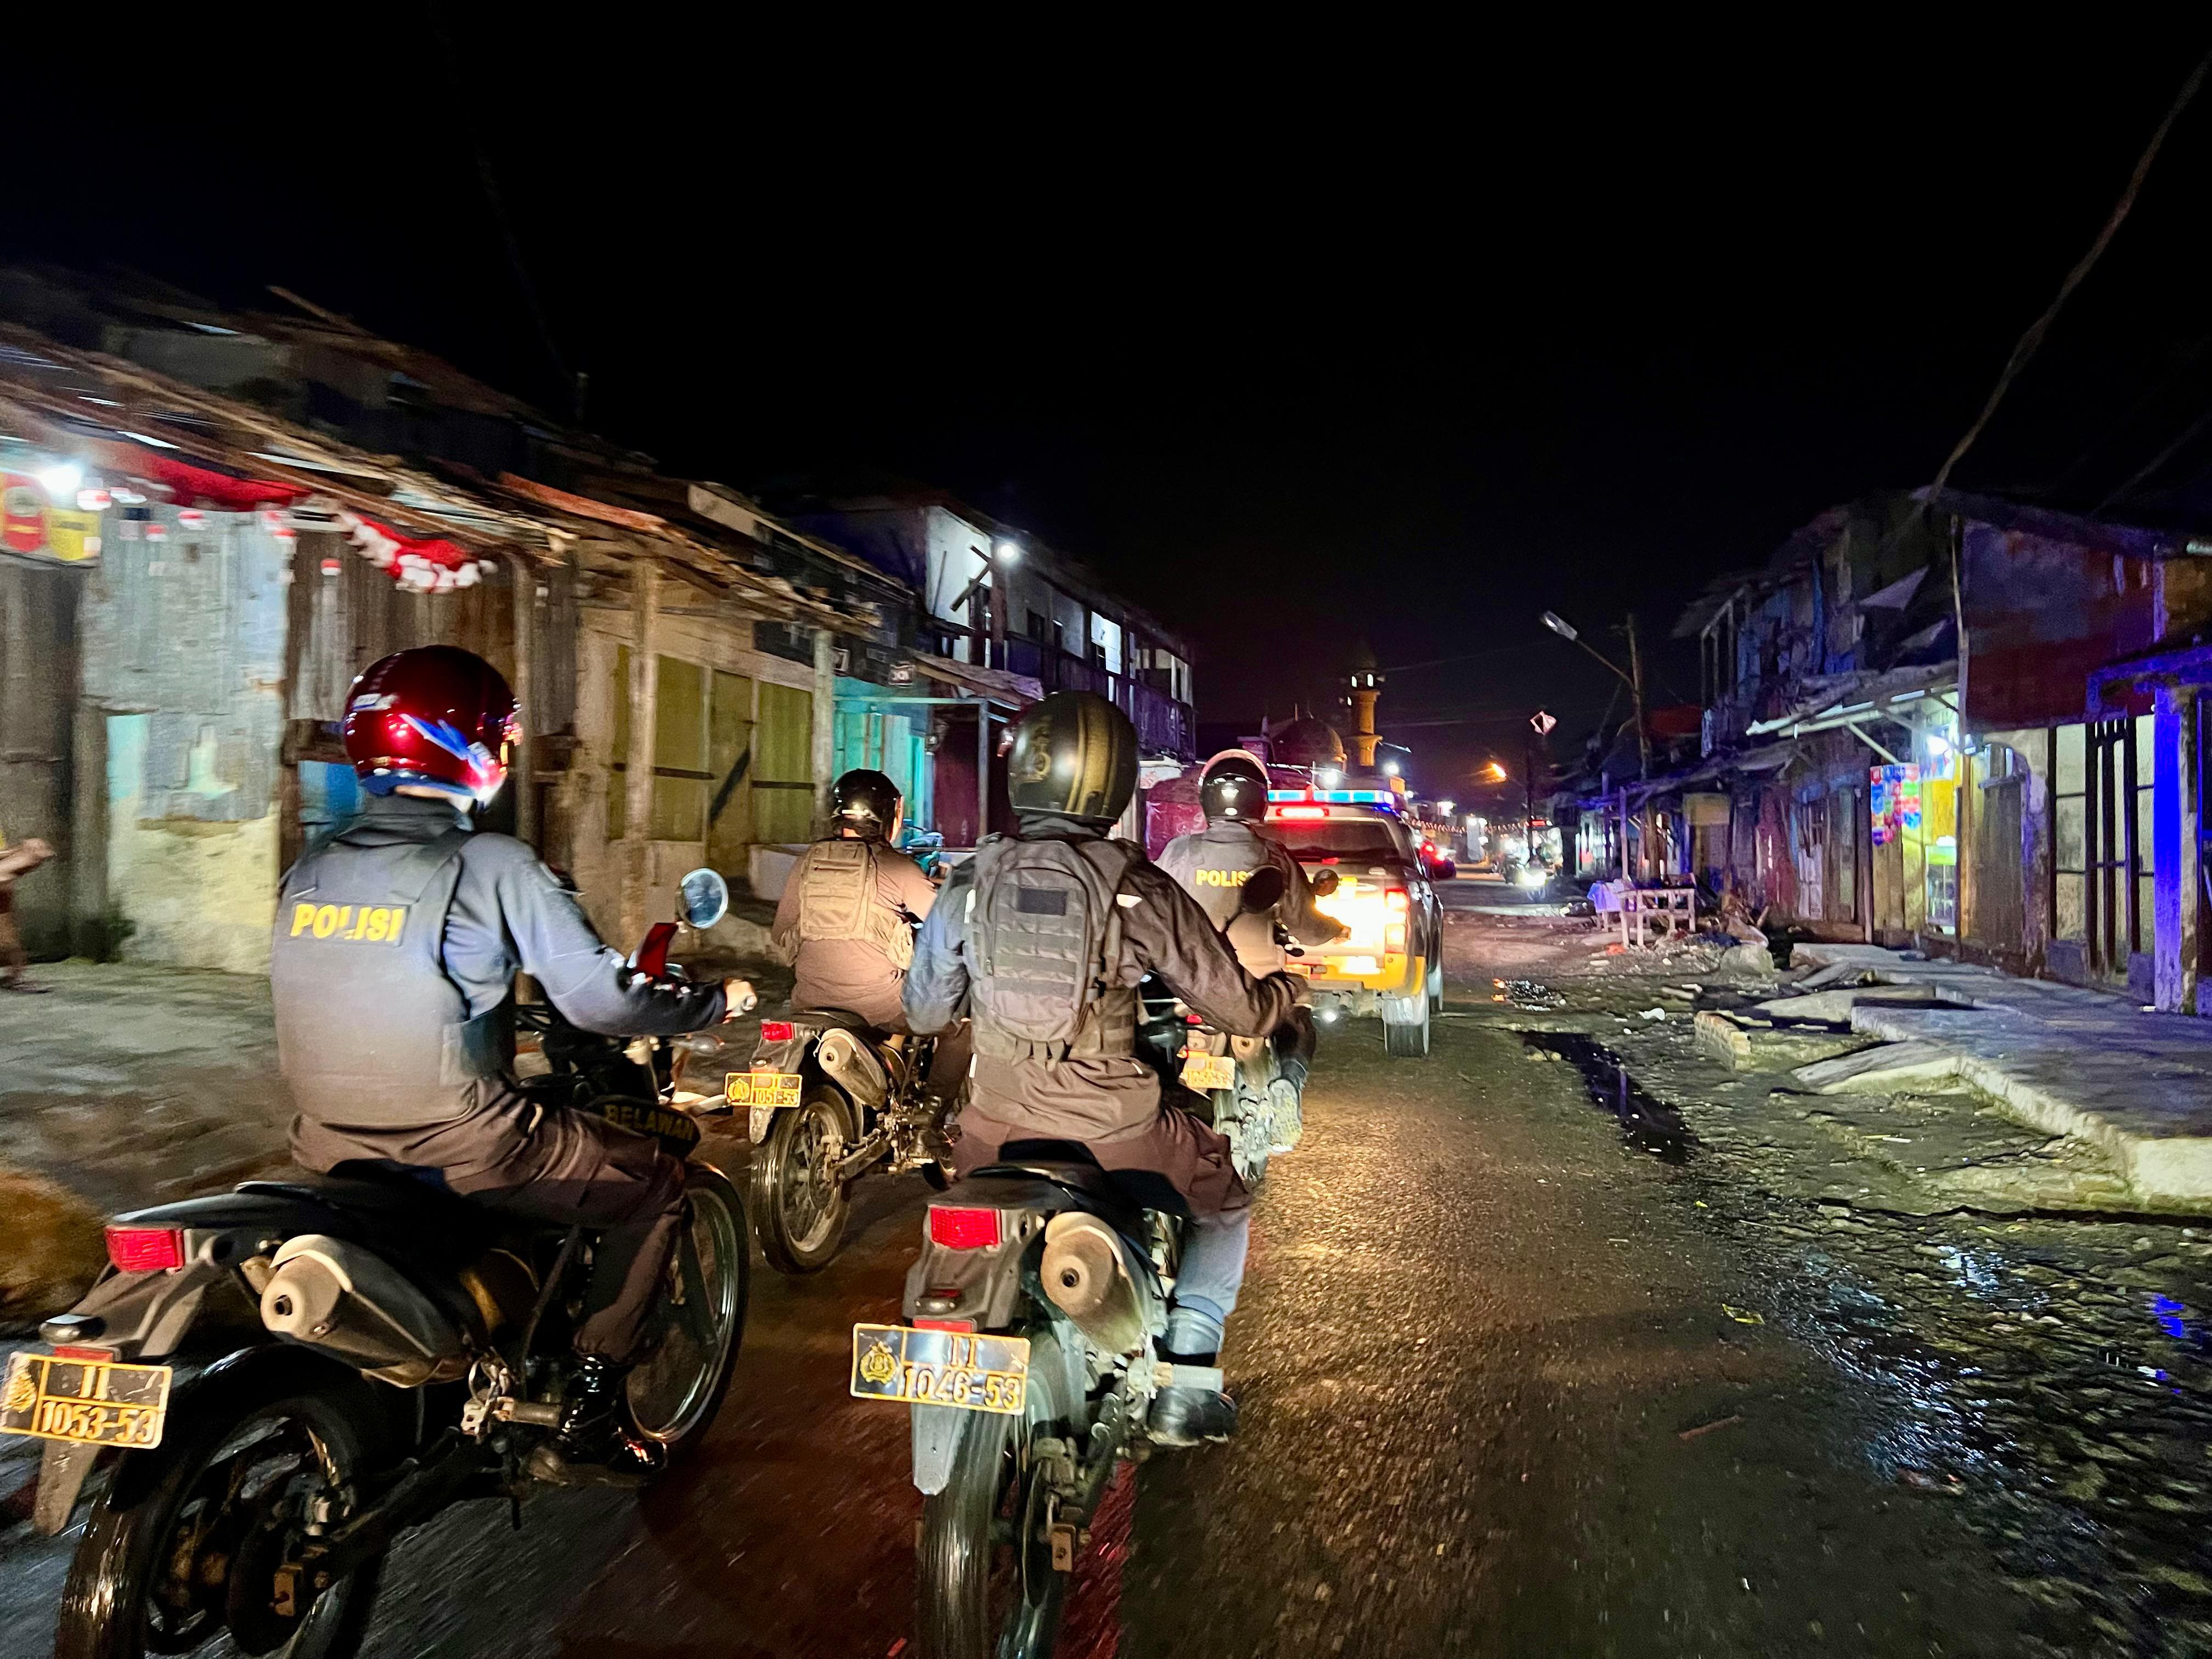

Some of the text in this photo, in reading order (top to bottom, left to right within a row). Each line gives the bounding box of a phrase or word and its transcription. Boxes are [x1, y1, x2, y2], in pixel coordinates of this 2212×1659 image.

[1196, 868, 1248, 887] POLIS
[290, 903, 405, 942] POLISI
[605, 1104, 695, 1142] BELAWAN
[904, 1367, 1021, 1410] 1046-53
[41, 1401, 159, 1443] 1053-53
